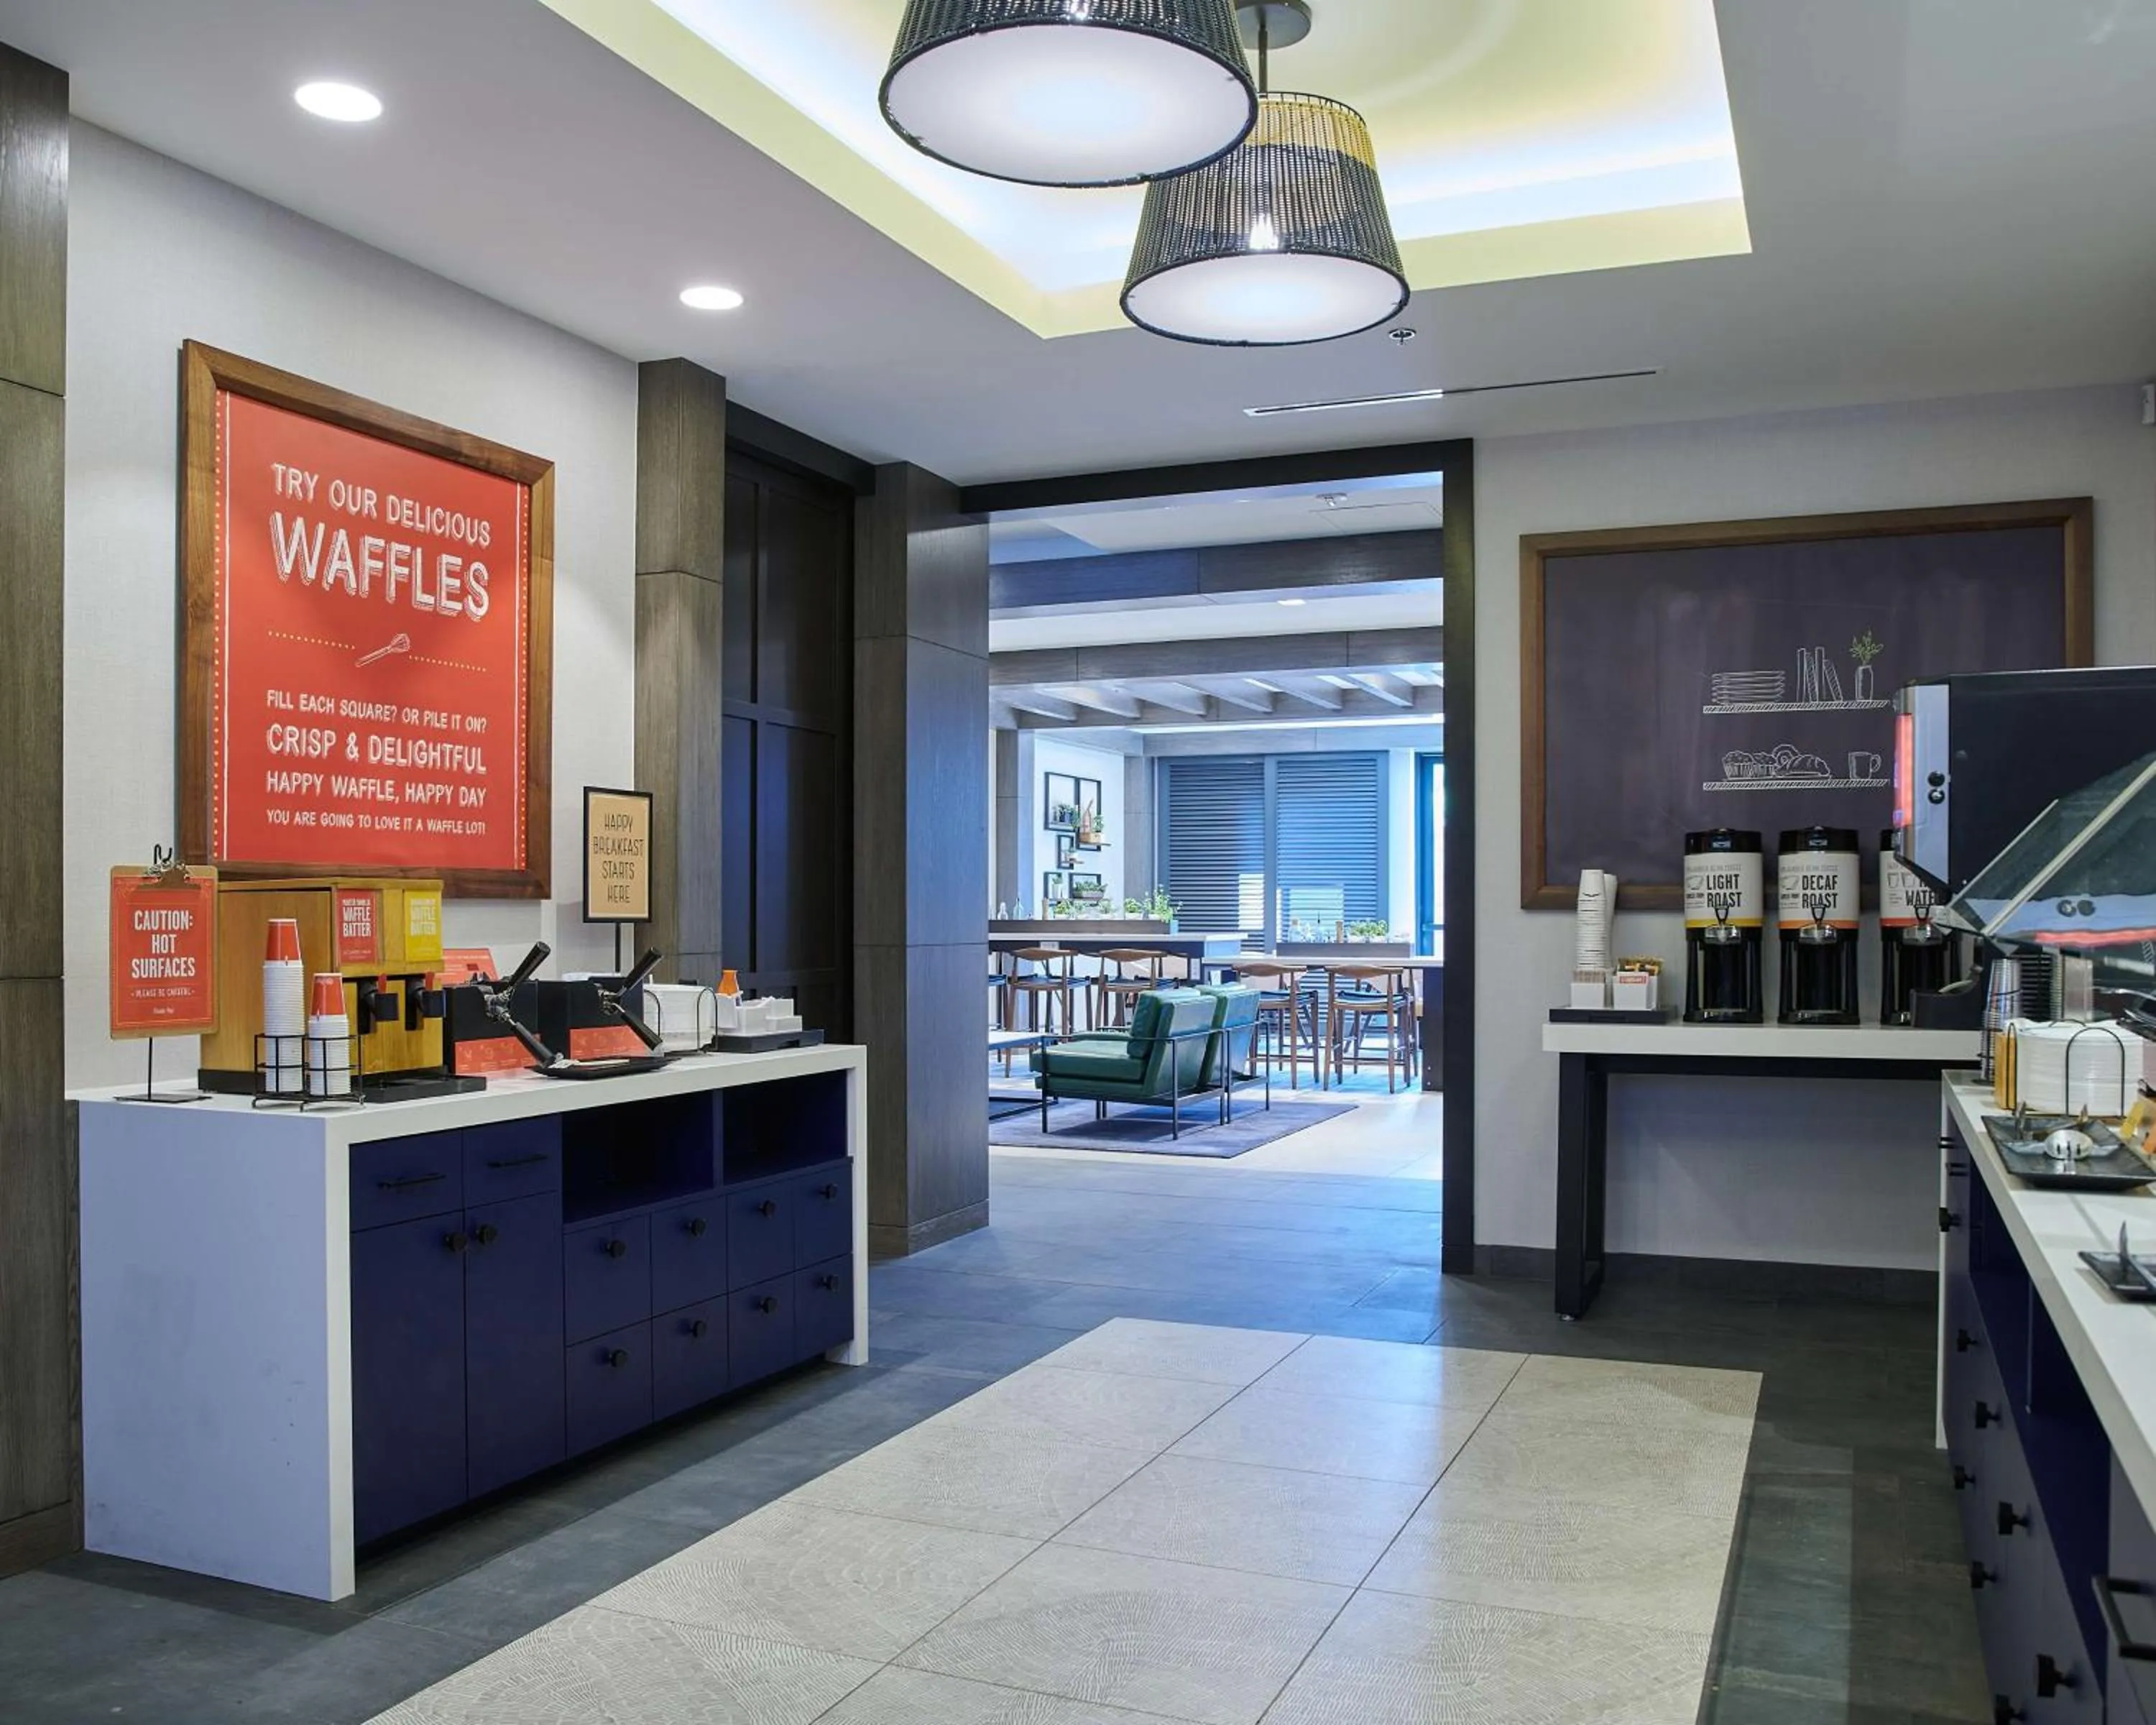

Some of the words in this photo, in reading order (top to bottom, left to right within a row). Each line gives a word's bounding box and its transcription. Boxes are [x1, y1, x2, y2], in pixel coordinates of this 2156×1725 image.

[270, 462, 318, 501] TRY
[329, 479, 377, 519] OUR
[387, 494, 490, 548] DELICIOUS
[270, 511, 489, 622] WAFFLES
[267, 689, 293, 711] FILL
[299, 694, 334, 714] EACH
[340, 699, 397, 722] SQUARE?
[402, 707, 419, 724] OR
[423, 709, 447, 729] PILE
[451, 712, 461, 730] IT
[466, 715, 487, 733] ON?
[267, 723, 336, 758] CRISP
[346, 732, 360, 760] &
[369, 735, 487, 775] DELIGHTFUL
[267, 770, 324, 795] HAPPY
[331, 775, 400, 804] WAFFLE,
[405, 781, 453, 807] HAPPY
[459, 786, 487, 809] DAY
[267, 809, 290, 826] YOU
[294, 811, 316, 827] ARE
[321, 811, 354, 828] GOING
[358, 814, 372, 829] TO
[375, 815, 400, 831] LOVE
[404, 816, 413, 832] IT
[416, 818, 423, 832] A
[427, 818, 463, 834] WAFFLE
[466, 821, 486, 836] LOT!
[604, 814, 633, 832] HAPPY
[593, 836, 644, 857] BREAKFAST
[602, 860, 635, 880] STARTS
[1706, 873, 1740, 891] LIGHT
[1802, 875, 1838, 891] DECAF
[607, 885, 630, 903] HERE
[1707, 892, 1742, 908] ROAST
[1802, 893, 1838, 908] ROAST
[1905, 889, 1938, 906] WATE
[134, 910, 193, 930] CAUTION:
[343, 906, 371, 922] WAFFLE
[343, 922, 372, 937] BATTER
[152, 934, 177, 954] HOT
[132, 957, 195, 979] SURFACES
